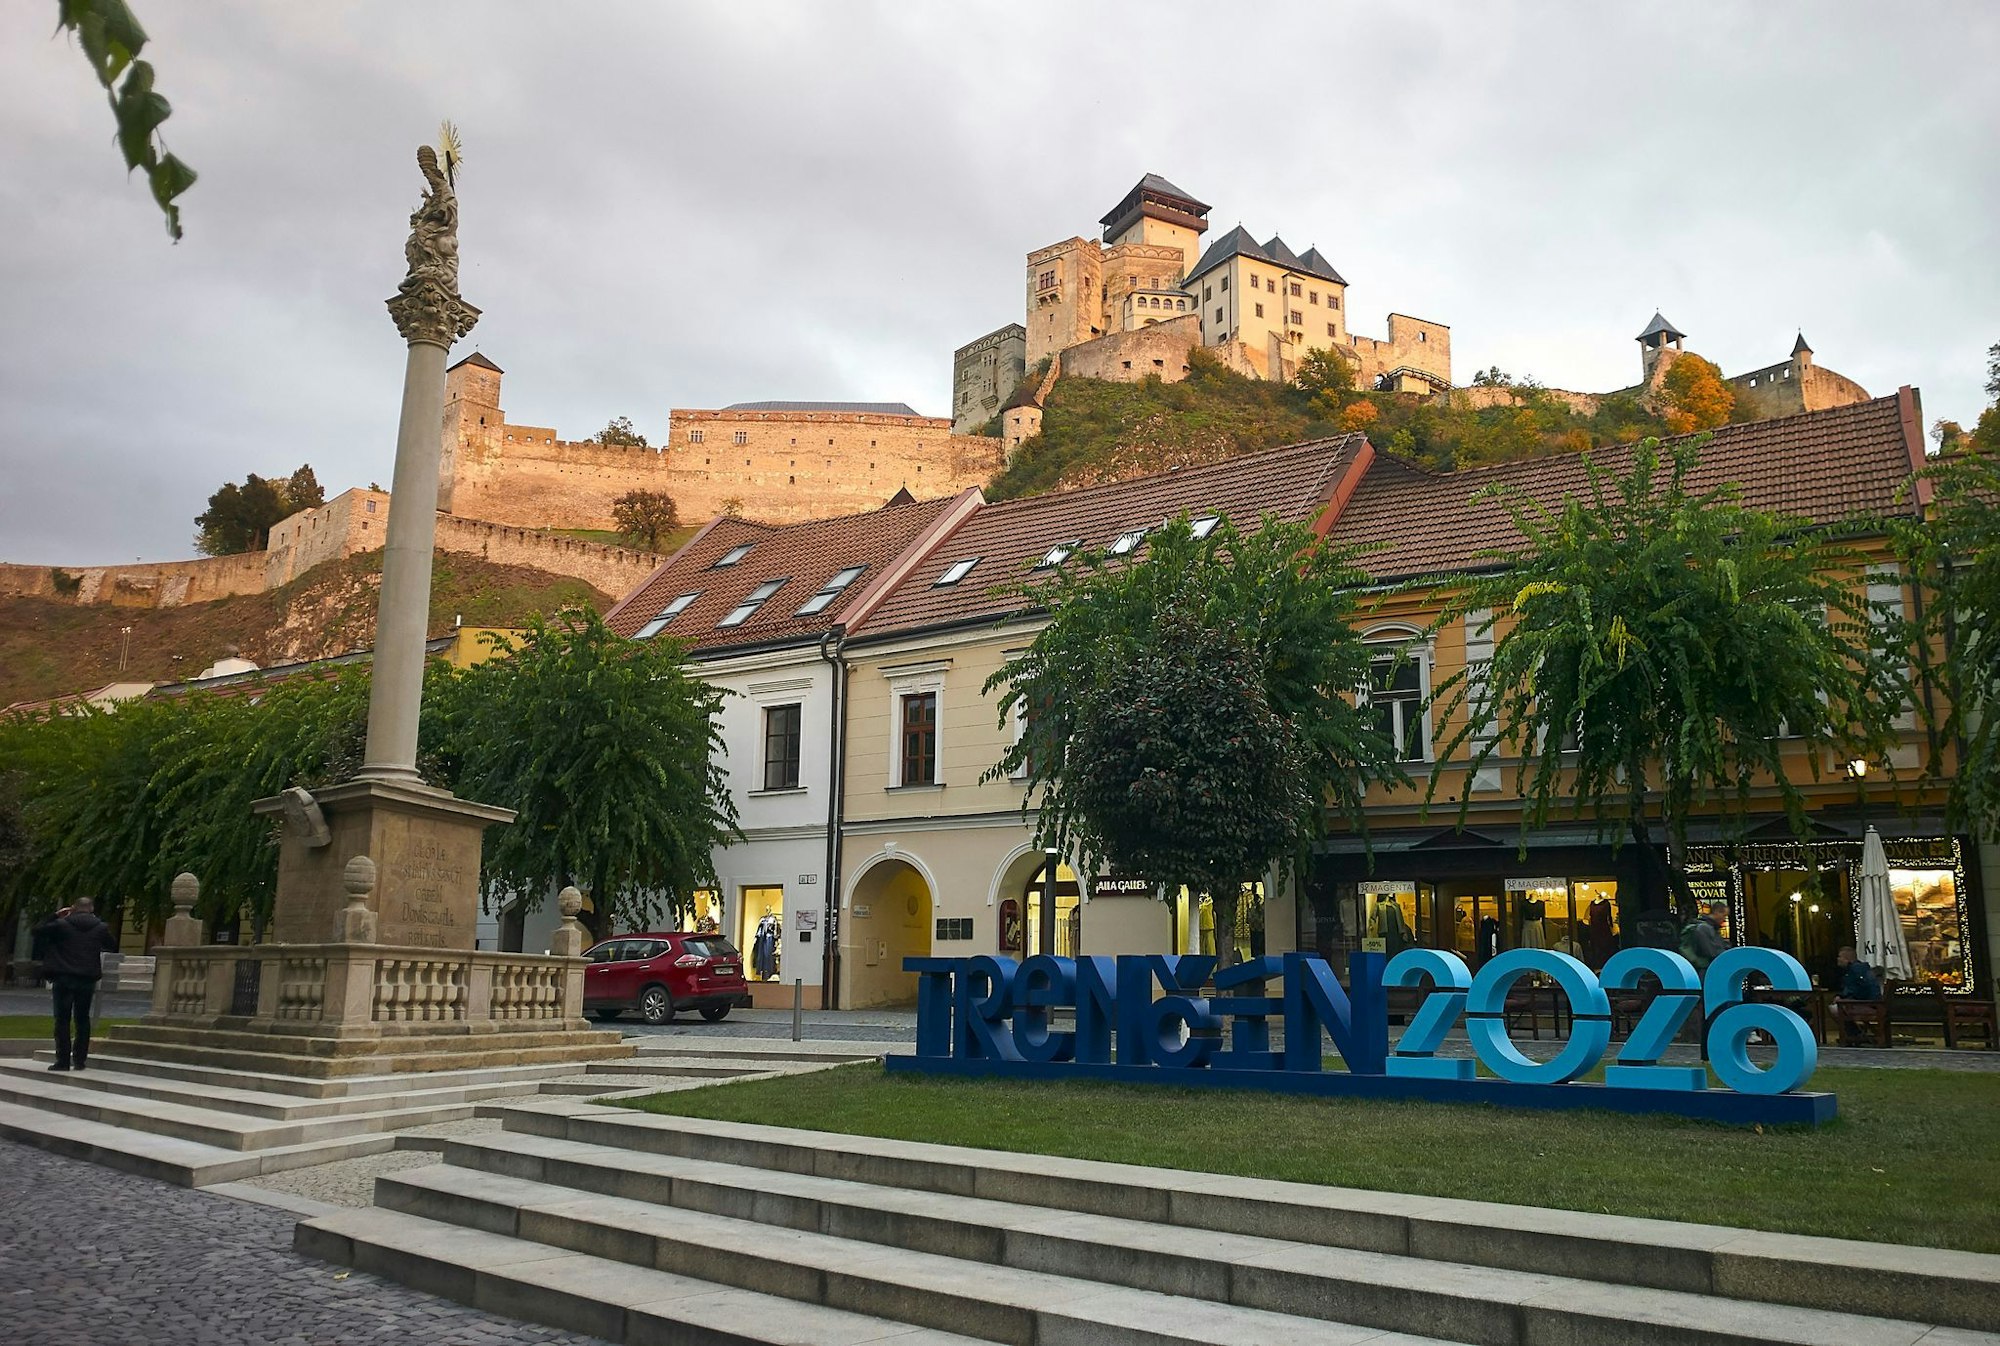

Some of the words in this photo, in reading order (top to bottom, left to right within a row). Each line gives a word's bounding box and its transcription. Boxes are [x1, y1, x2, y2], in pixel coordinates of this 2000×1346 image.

[1884, 845, 1925, 857] OVAR
[1370, 884, 1413, 892] MAGENTA
[1518, 880, 1566, 889] MAGENTA
[1690, 888, 1728, 898] VOVAR
[1382, 946, 1818, 1094] 2026
